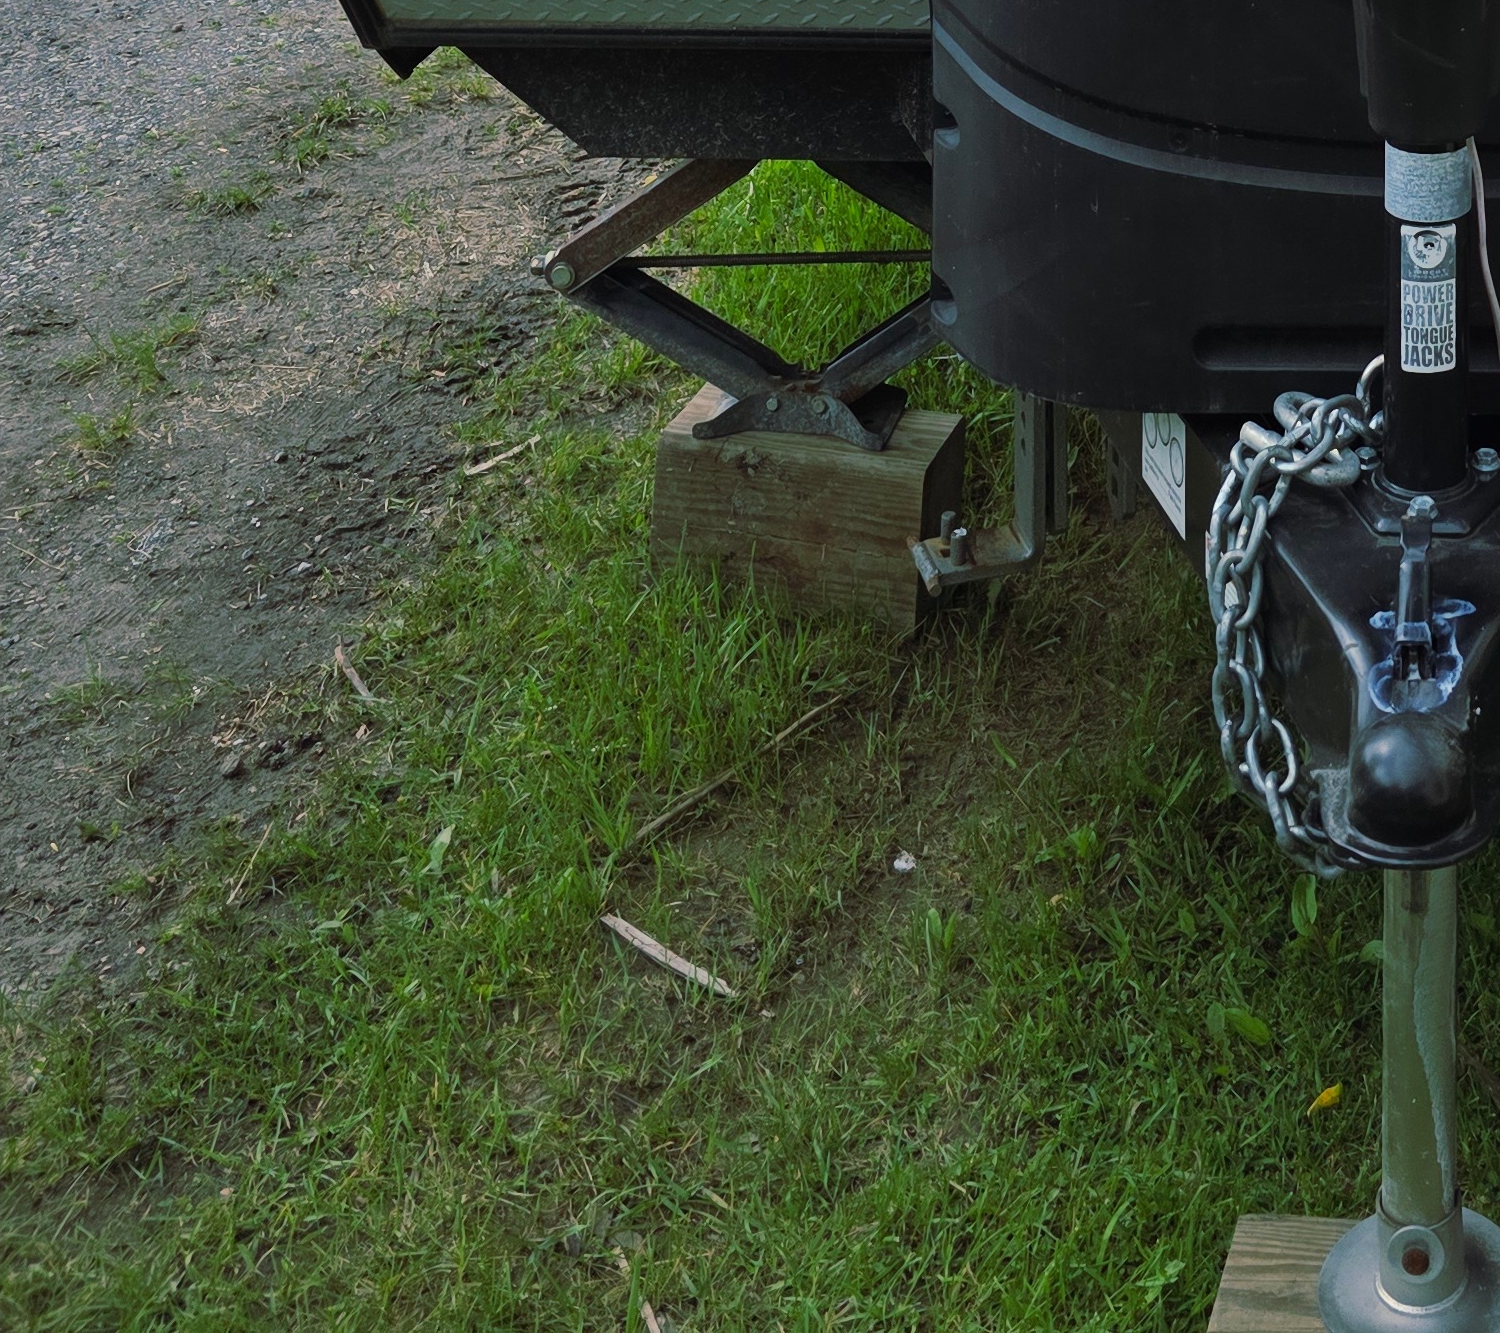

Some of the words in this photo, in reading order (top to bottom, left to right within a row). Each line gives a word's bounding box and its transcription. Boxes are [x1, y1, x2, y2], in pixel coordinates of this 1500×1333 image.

[1403, 283, 1454, 304] POWER
[1403, 302, 1454, 328] DRIVE
[1403, 324, 1454, 345] TONGUE
[1403, 342, 1454, 367] JACKS
